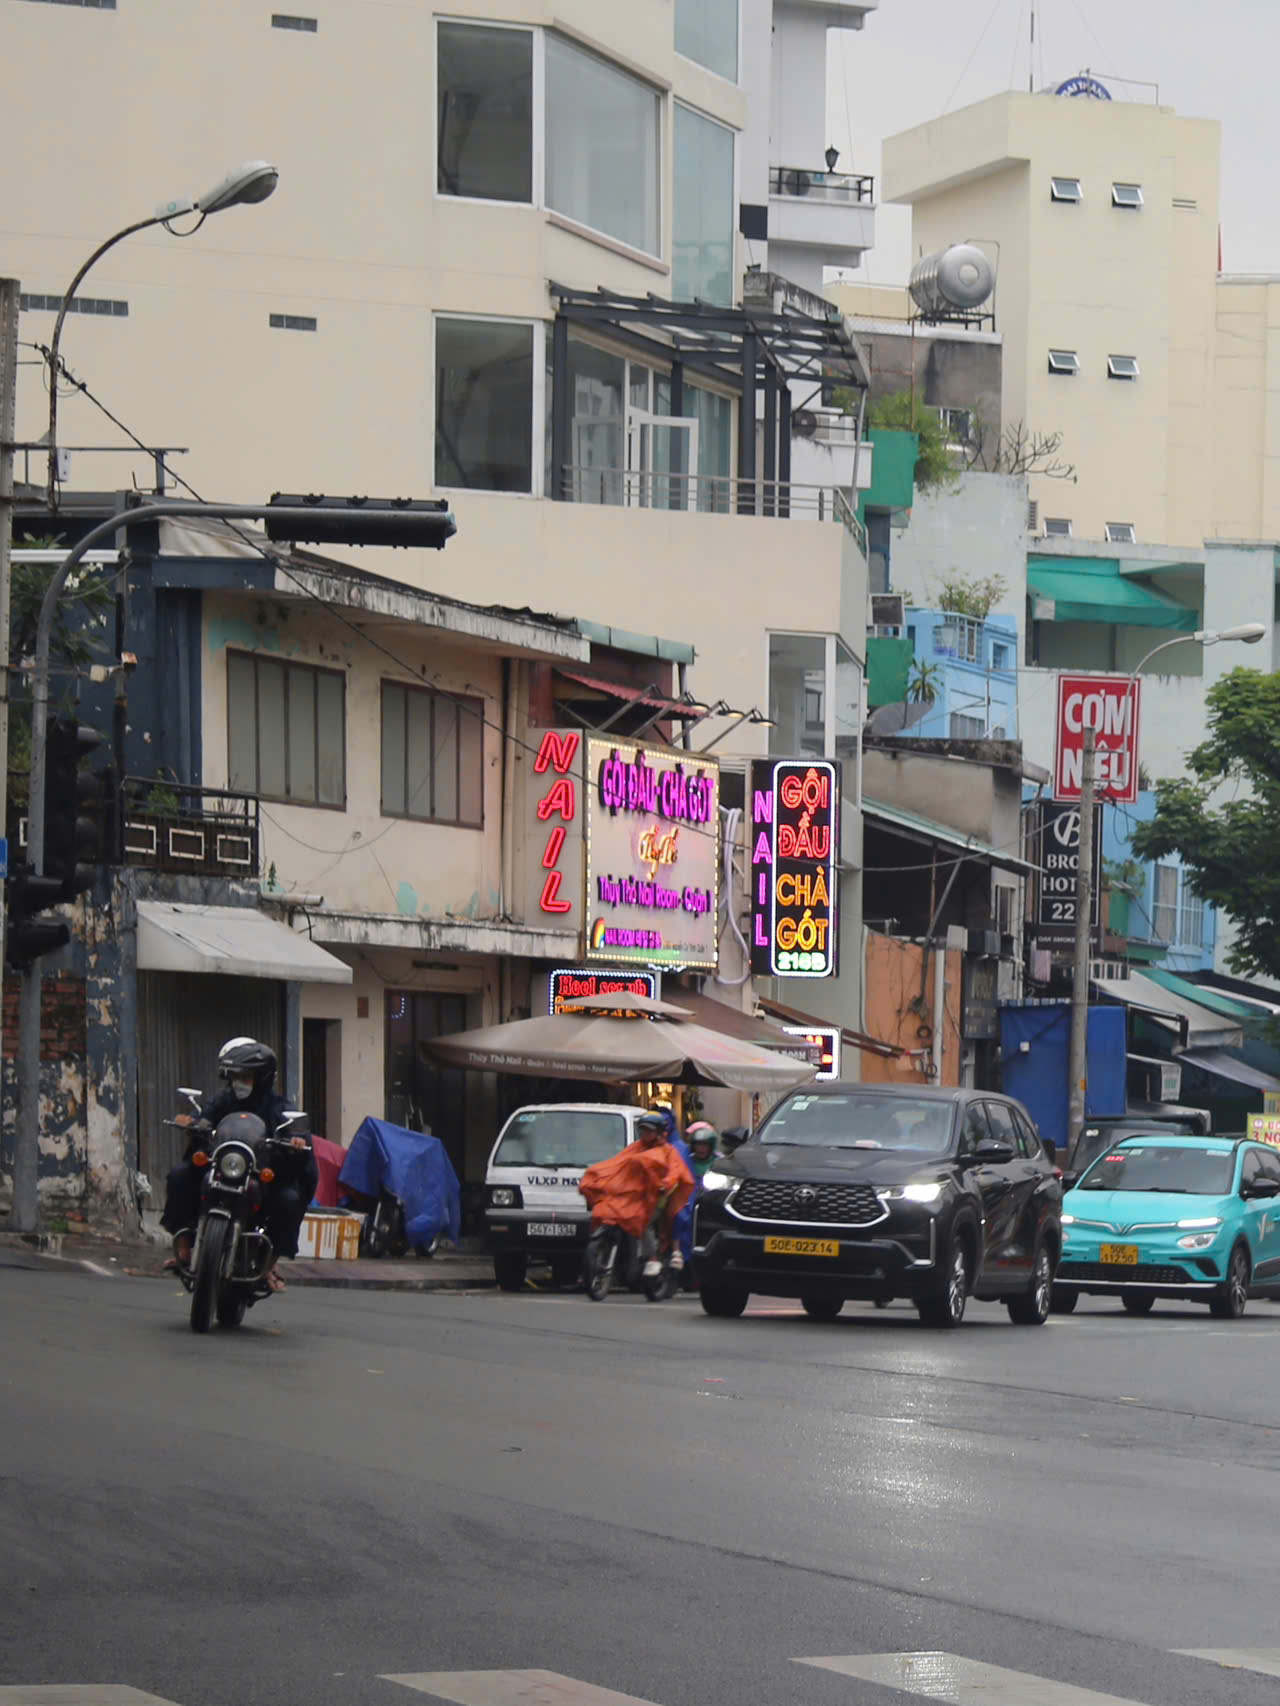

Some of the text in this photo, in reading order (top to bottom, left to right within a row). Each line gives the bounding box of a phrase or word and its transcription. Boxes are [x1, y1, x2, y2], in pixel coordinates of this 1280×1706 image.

[1065, 689, 1132, 736] CƠM
[599, 748, 627, 816] GỘI
[627, 748, 656, 812] ĐẦU
[658, 763, 687, 819] CHÀ
[686, 769, 715, 824] GÓT
[1062, 739, 1131, 791] NÊU
[780, 768, 828, 815] GỘI
[534, 731, 579, 912] NAIL
[778, 811, 830, 859] ĐẦU
[753, 790, 773, 946] NAIL
[776, 865, 830, 907] CHÀ
[776, 908, 829, 951] GÓT
[558, 975, 596, 996] Heel
[528, 1176, 558, 1186] VLXD
